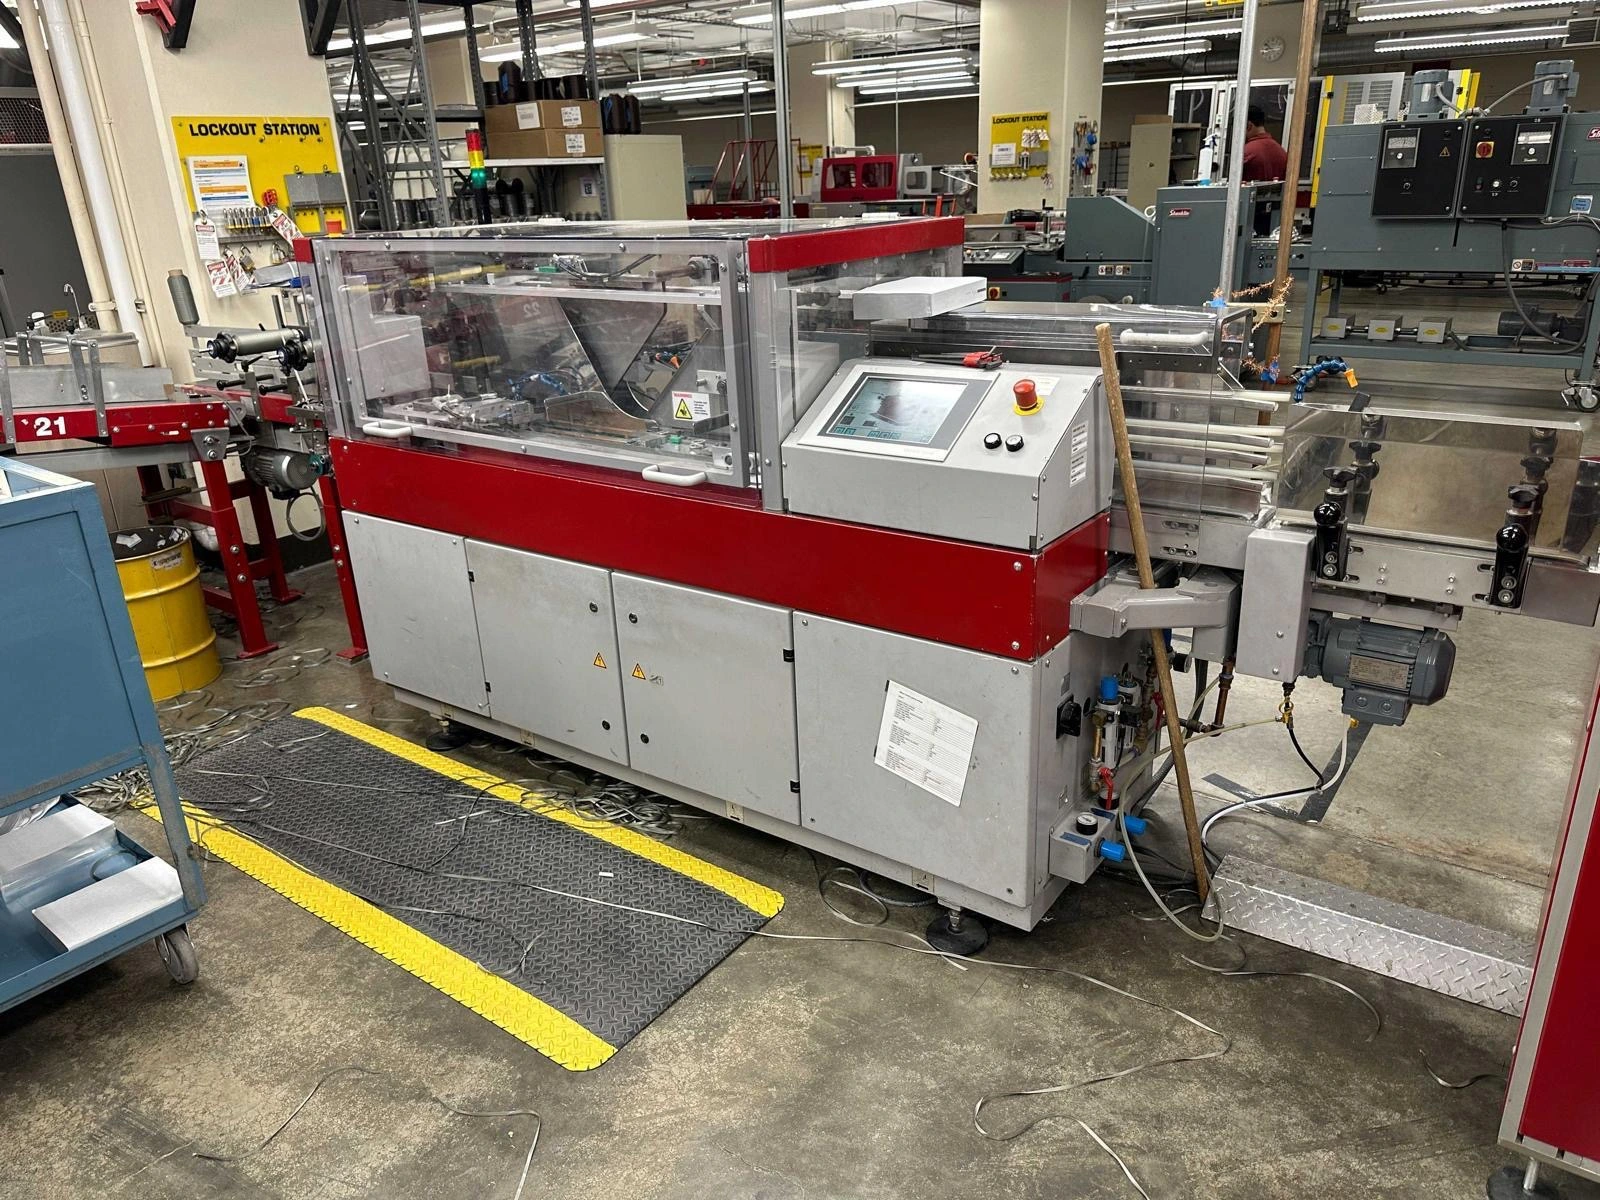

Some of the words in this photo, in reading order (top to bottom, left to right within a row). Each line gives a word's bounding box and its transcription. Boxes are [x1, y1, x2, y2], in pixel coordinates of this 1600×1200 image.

[992, 116, 1020, 124] LOCKOUT
[1022, 114, 1048, 122] STATION
[189, 123, 257, 137] LOCKOUT
[263, 123, 320, 136] STATION
[34, 416, 66, 437] 21
